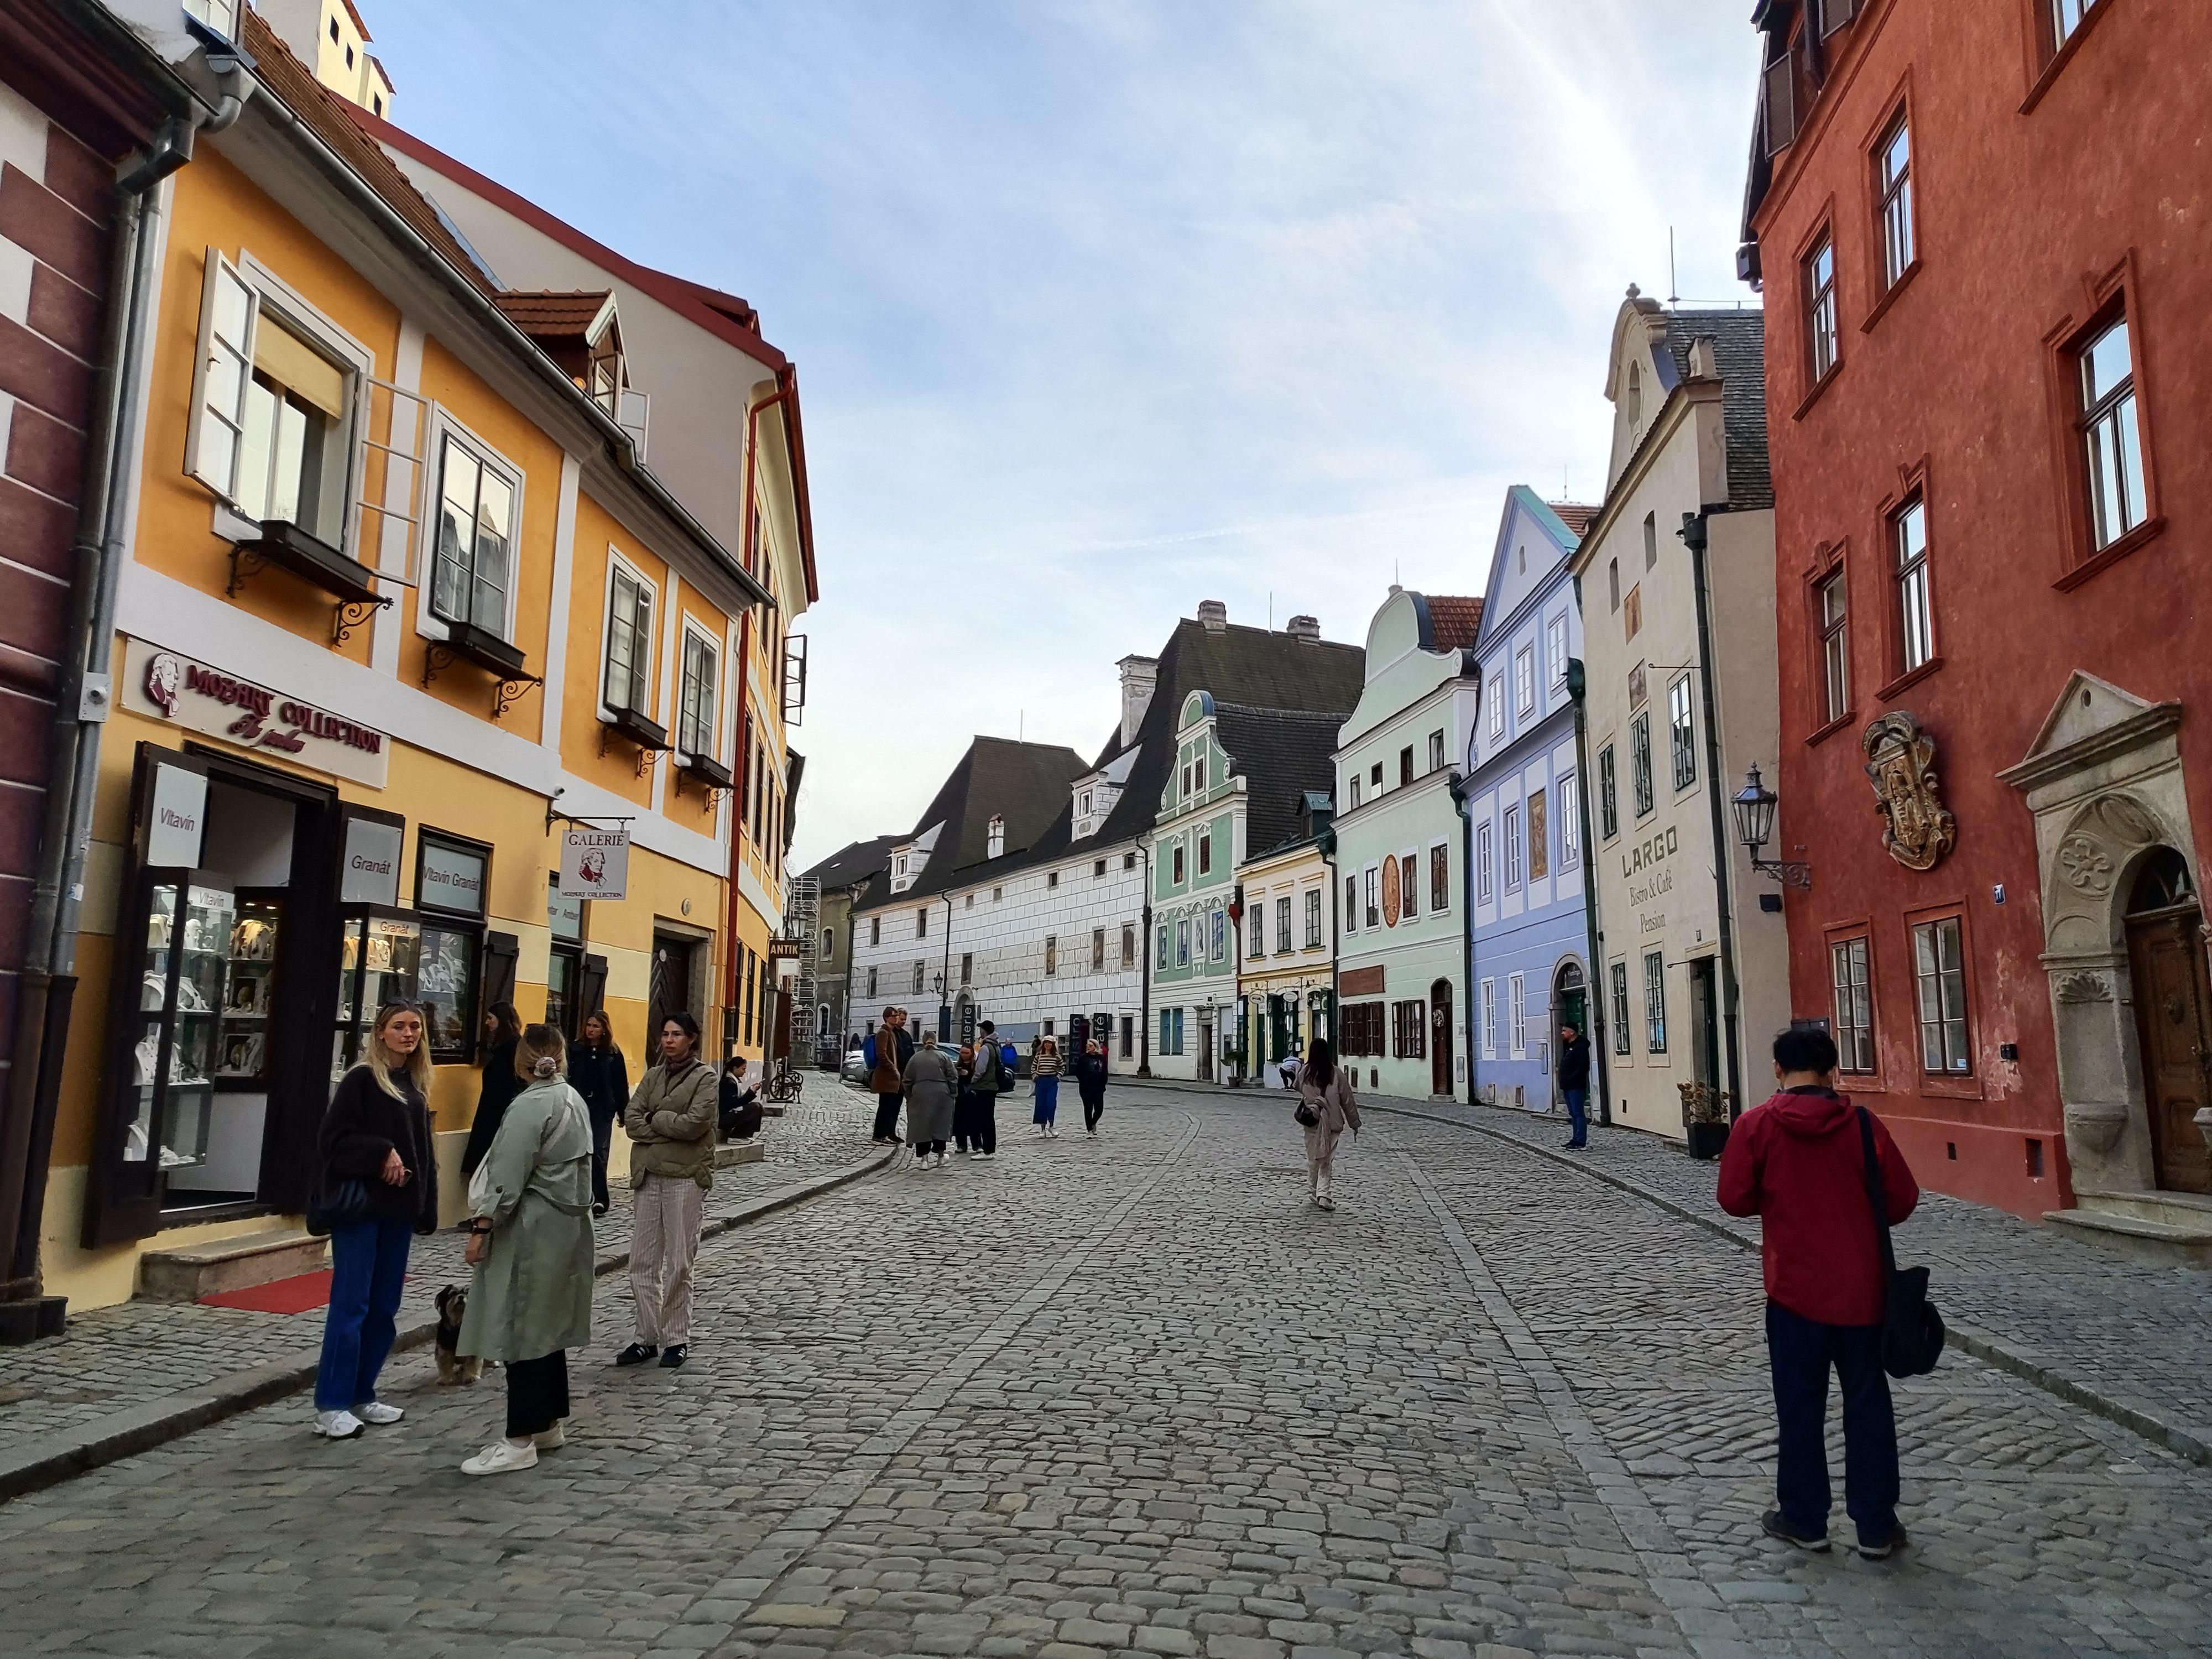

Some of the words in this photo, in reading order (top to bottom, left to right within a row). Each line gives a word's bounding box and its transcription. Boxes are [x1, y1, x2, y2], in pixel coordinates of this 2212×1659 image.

[279, 702, 382, 754] COLLECTION
[161, 807, 195, 831] Vltavín
[568, 834, 624, 847] GALERIE
[1622, 825, 1678, 879] LARGO
[352, 855, 391, 875] Granát
[1630, 886, 1648, 907] Bistro
[380, 921, 409, 934] Granát
[770, 944, 798, 954] ANTIK
[962, 1007, 972, 1044] alerie
[1094, 1016, 1104, 1043] afé
